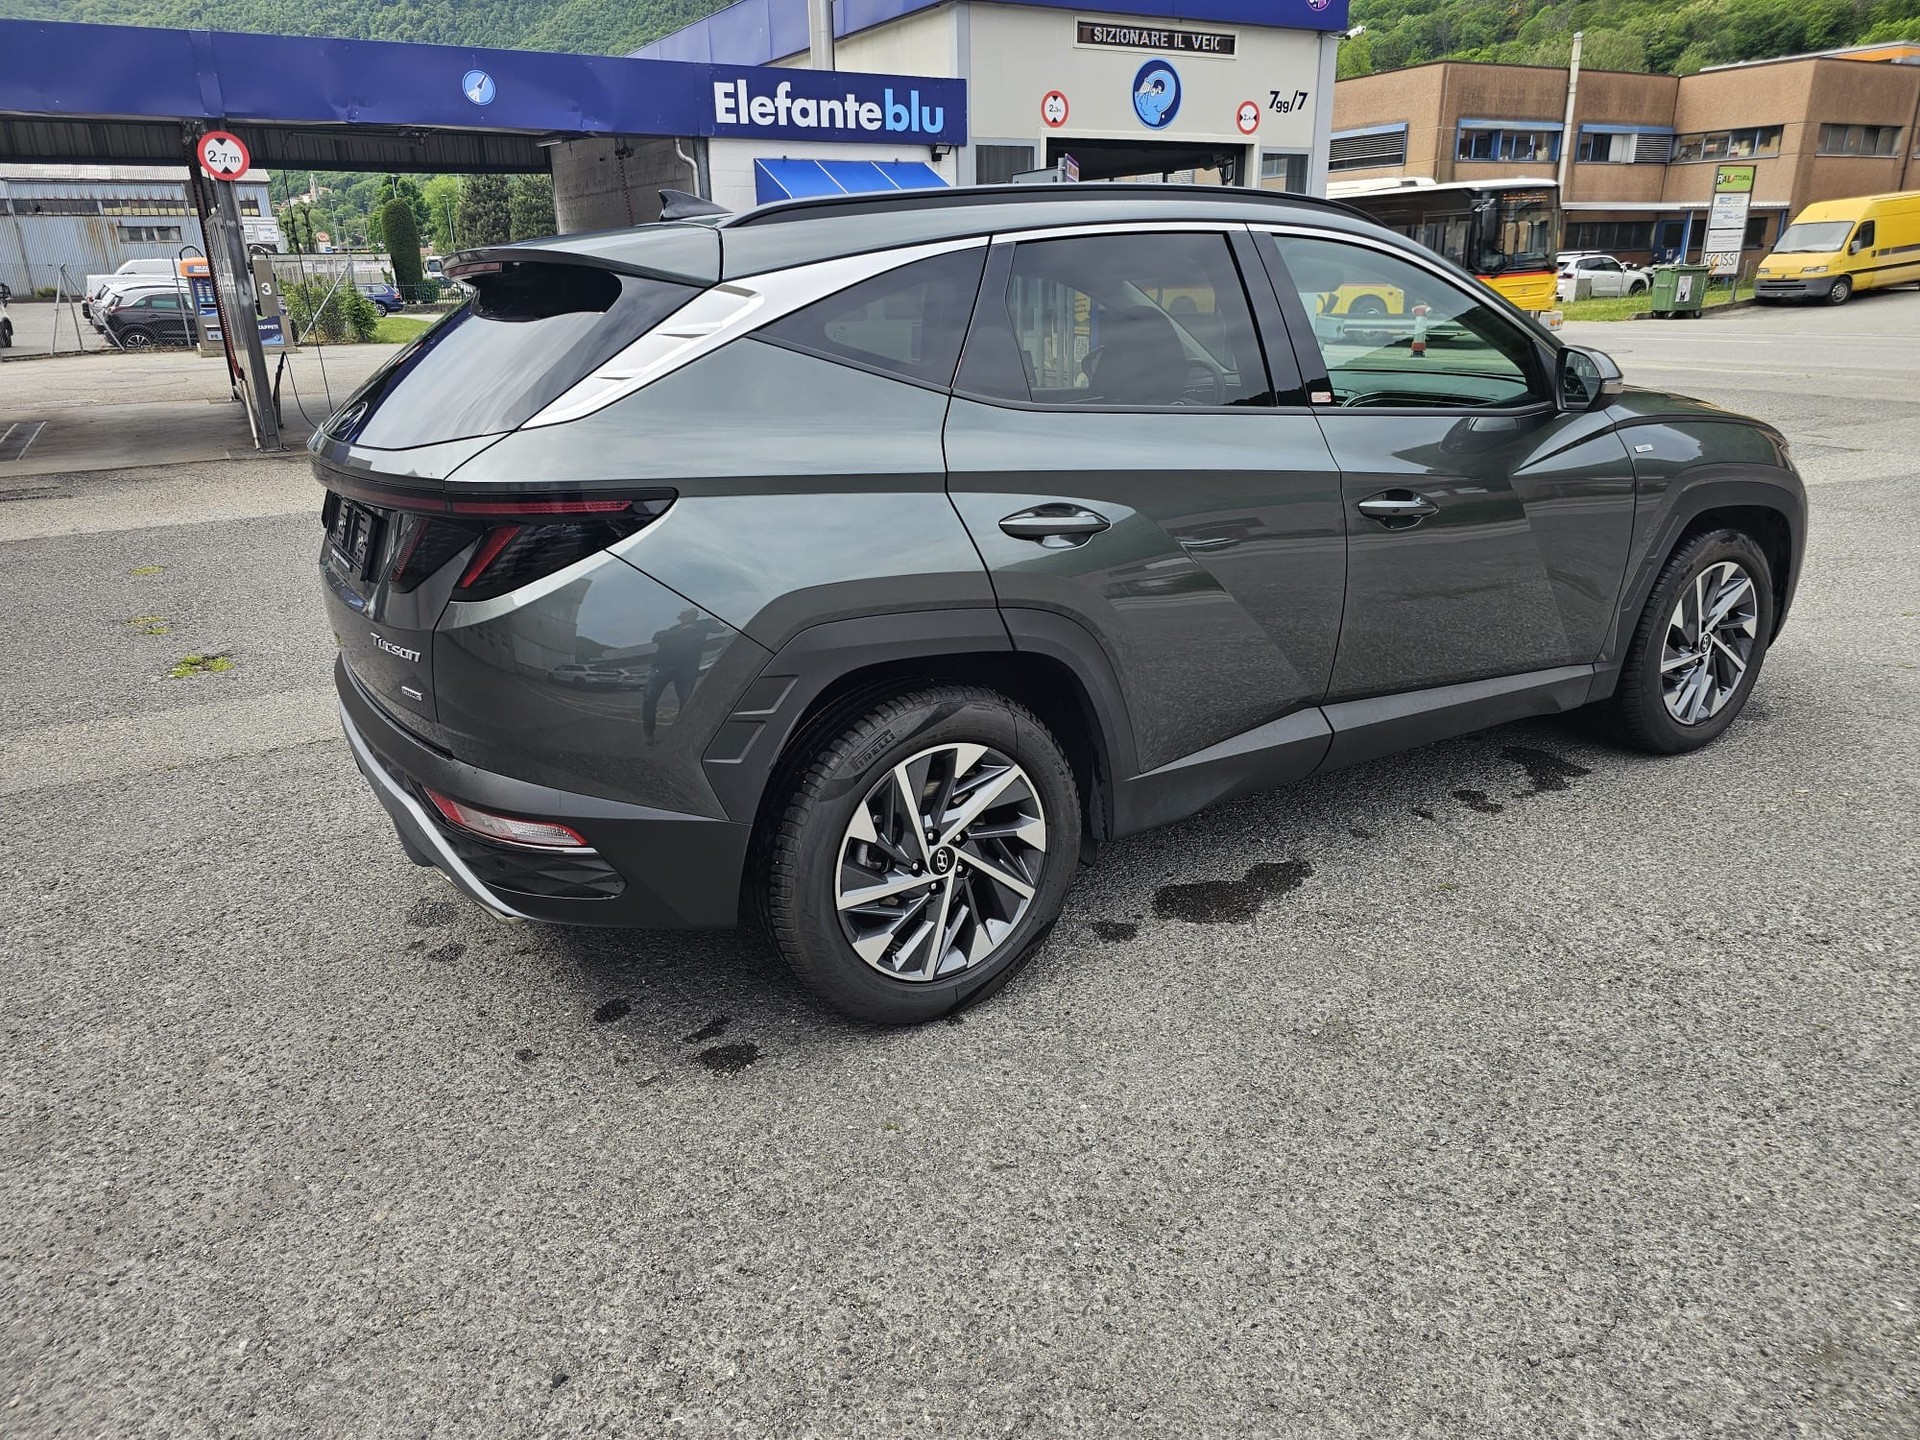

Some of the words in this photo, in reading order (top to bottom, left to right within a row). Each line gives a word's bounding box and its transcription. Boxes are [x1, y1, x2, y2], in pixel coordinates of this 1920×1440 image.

[1094, 26, 1168, 47] SIZIONARE
[1174, 33, 1185, 48] IL
[713, 79, 944, 134] Elefanteblu
[1269, 90, 1308, 113] 7gg/7
[261, 283, 272, 295] 3
